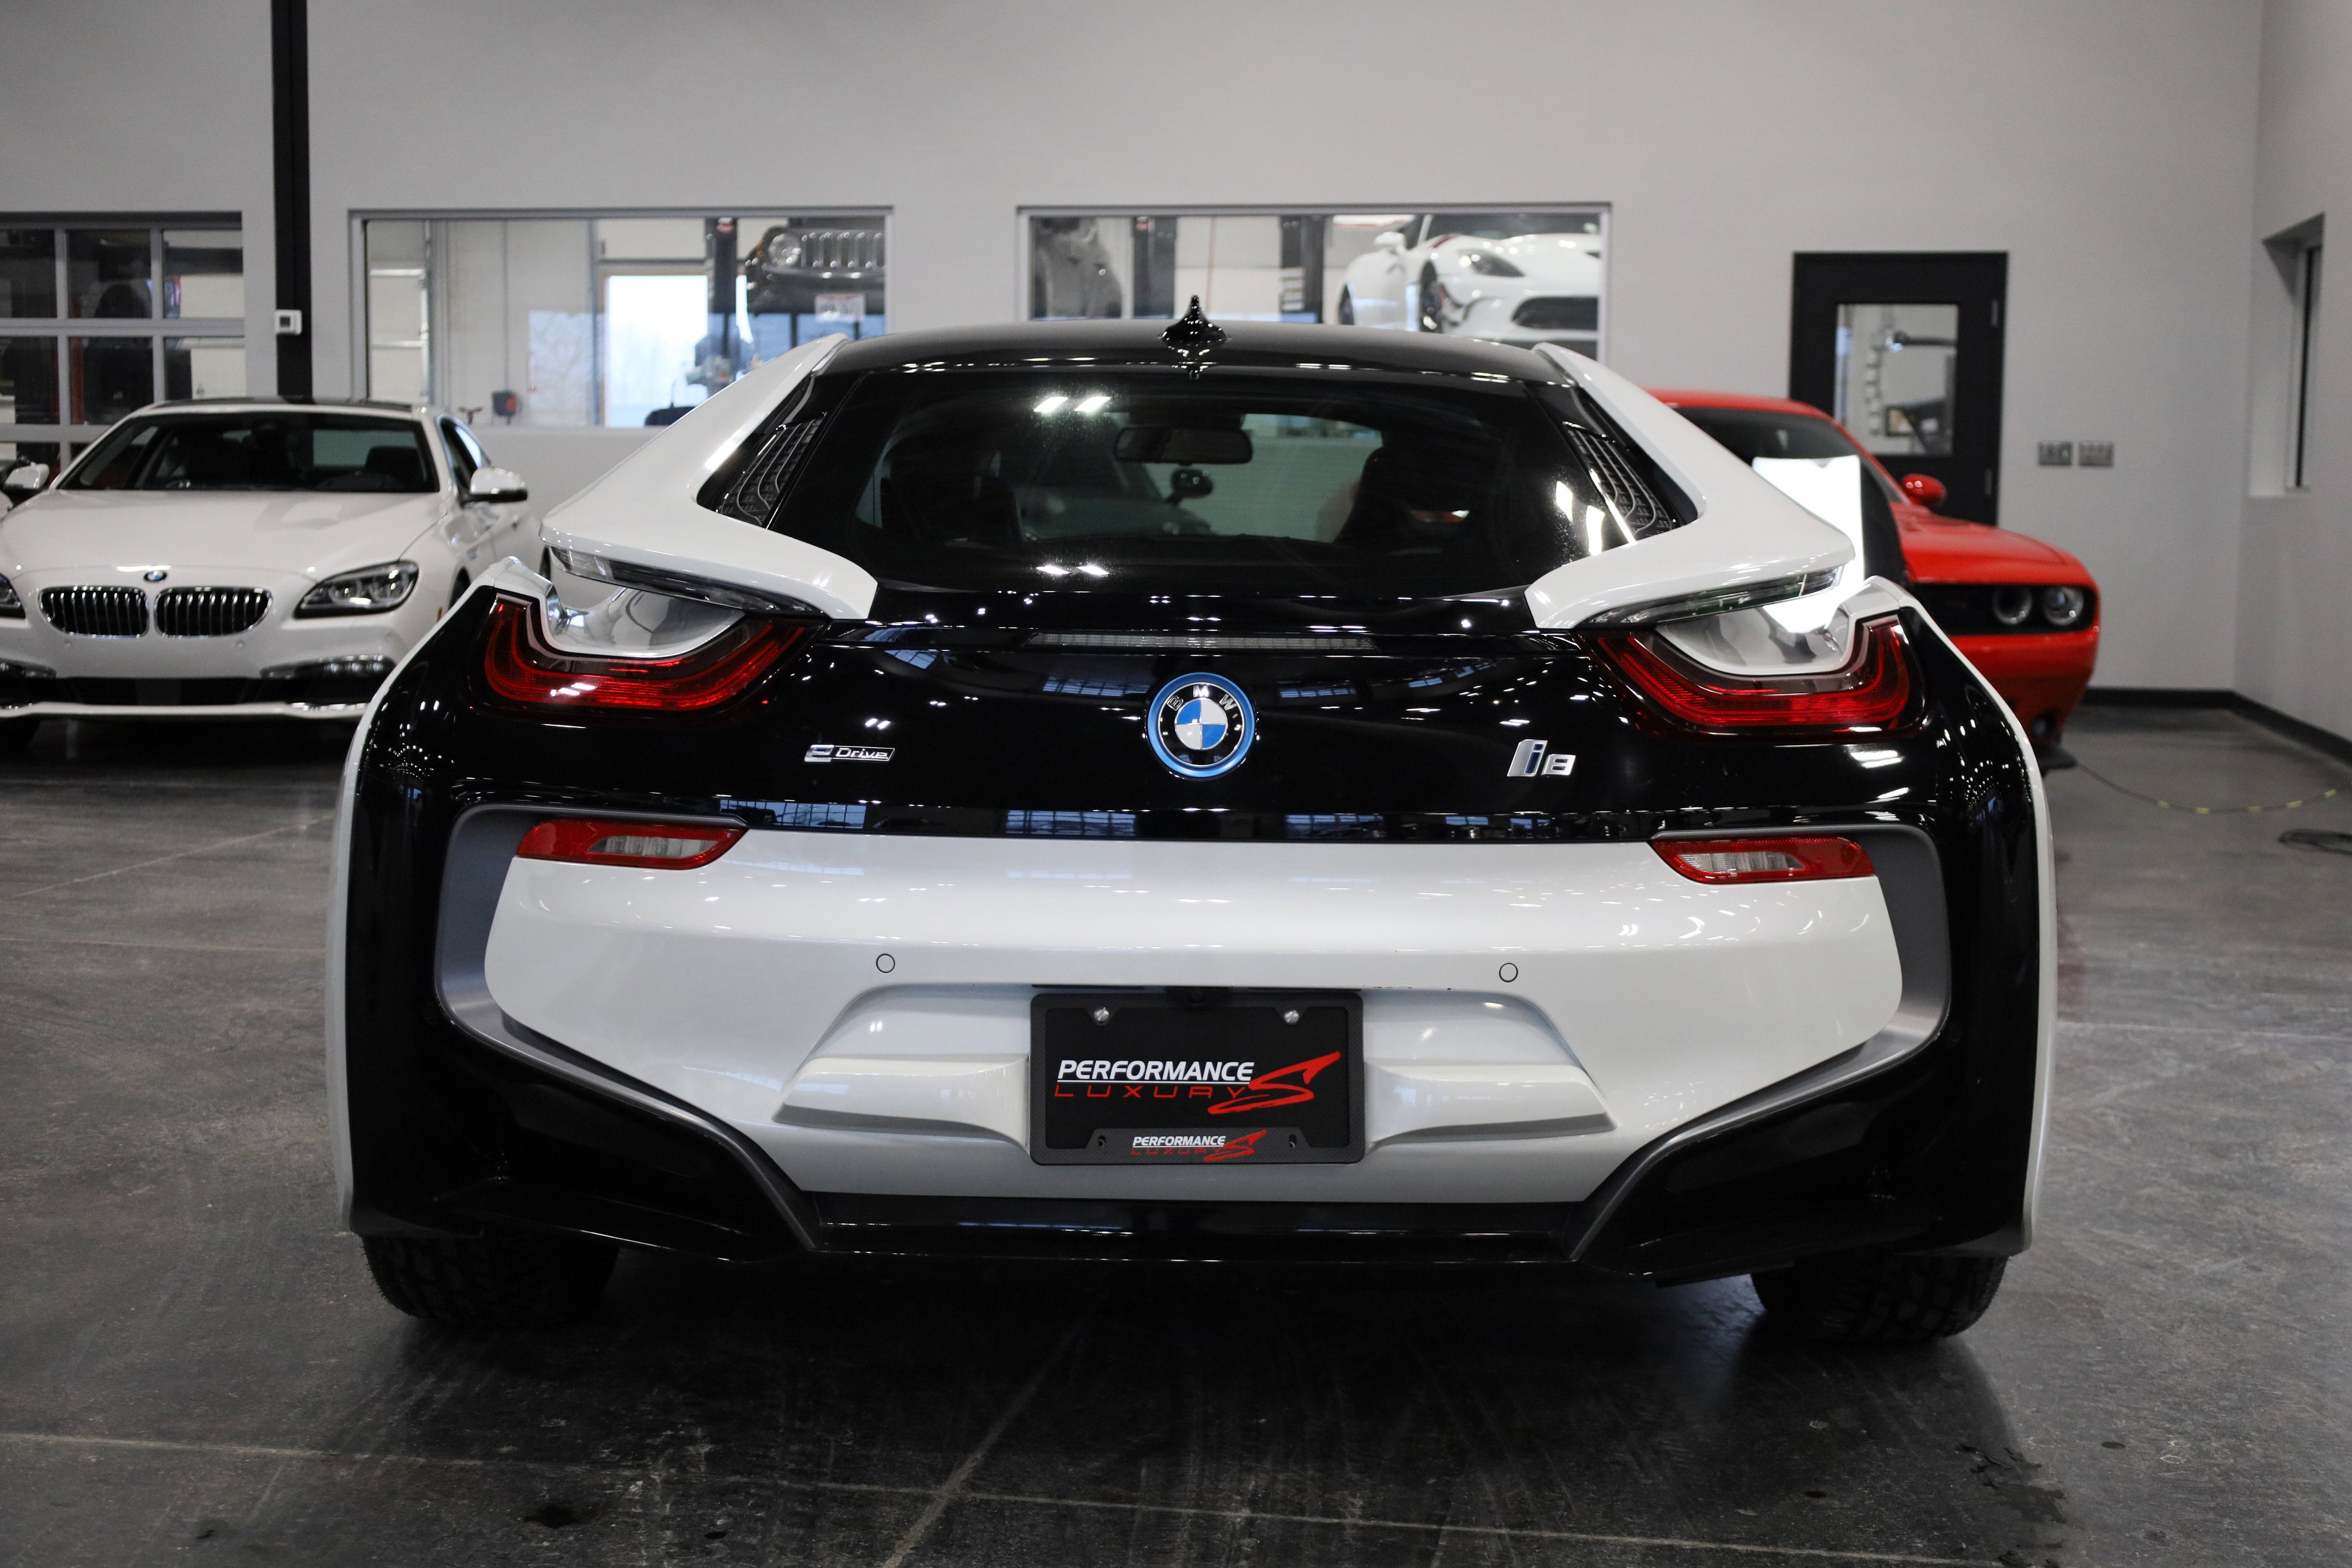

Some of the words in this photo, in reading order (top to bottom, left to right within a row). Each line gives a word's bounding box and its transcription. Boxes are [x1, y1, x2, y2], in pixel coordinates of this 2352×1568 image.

[1167, 685, 1236, 711] BMW
[1507, 739, 1576, 777] i8
[1058, 1060, 1254, 1081] PERFORMANCE
[1054, 1085, 1245, 1098] LUXURY
[1132, 1135, 1226, 1146] PERFORMANCE
